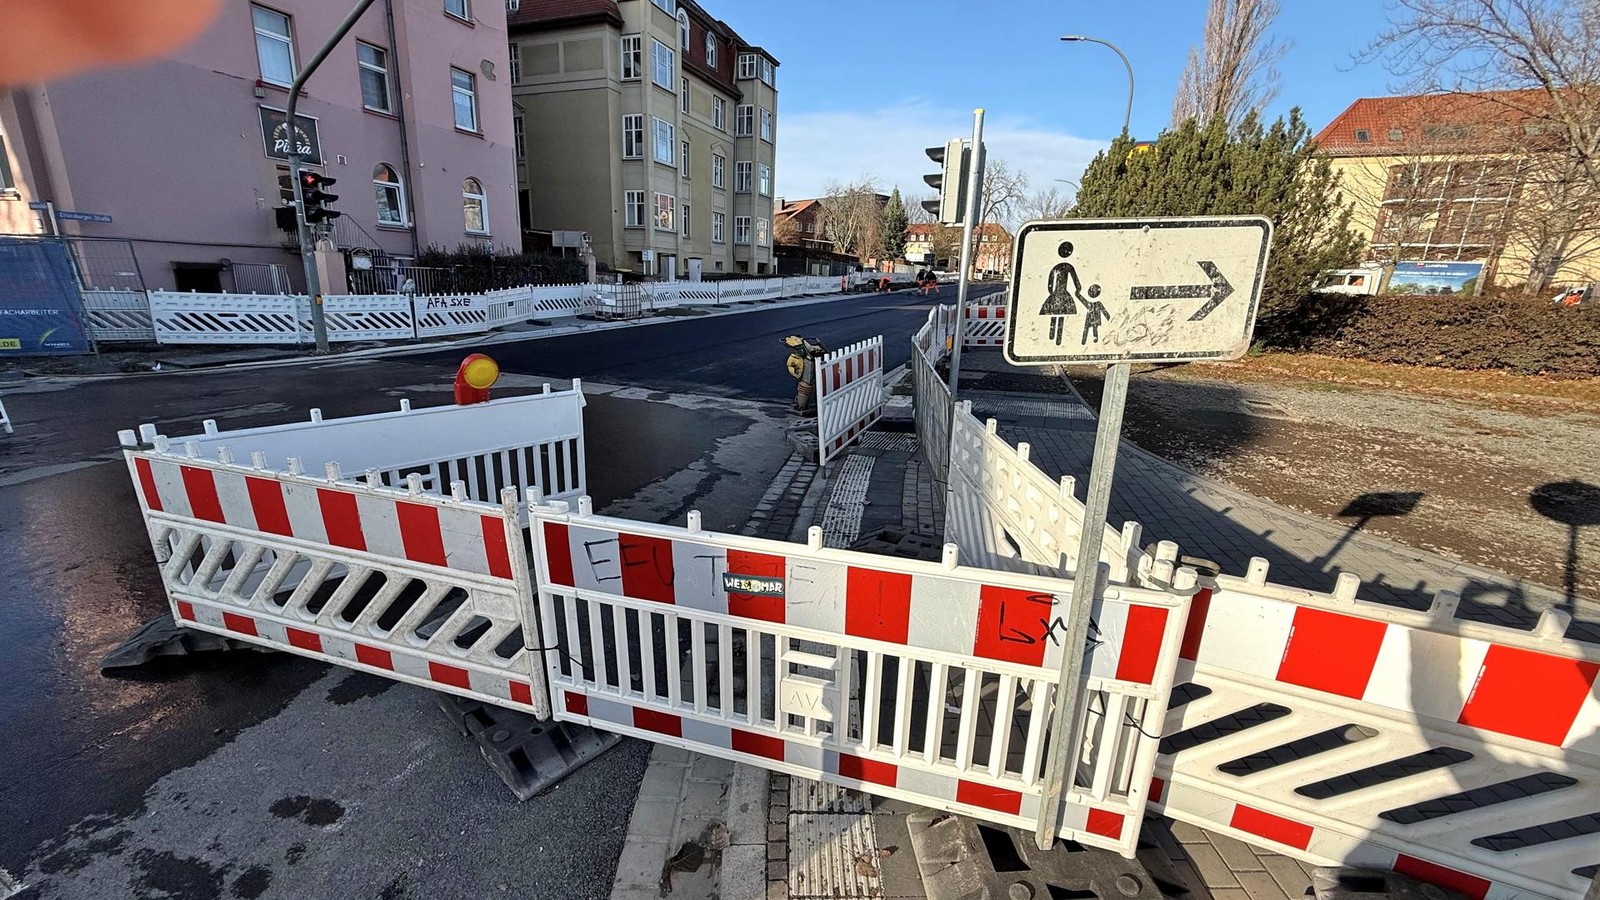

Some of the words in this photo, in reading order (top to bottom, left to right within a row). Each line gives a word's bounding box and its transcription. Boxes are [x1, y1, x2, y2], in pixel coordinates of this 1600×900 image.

[274, 139, 312, 155] Piza
[427, 298, 447, 309] AFA
[450, 298, 471, 306] SXE
